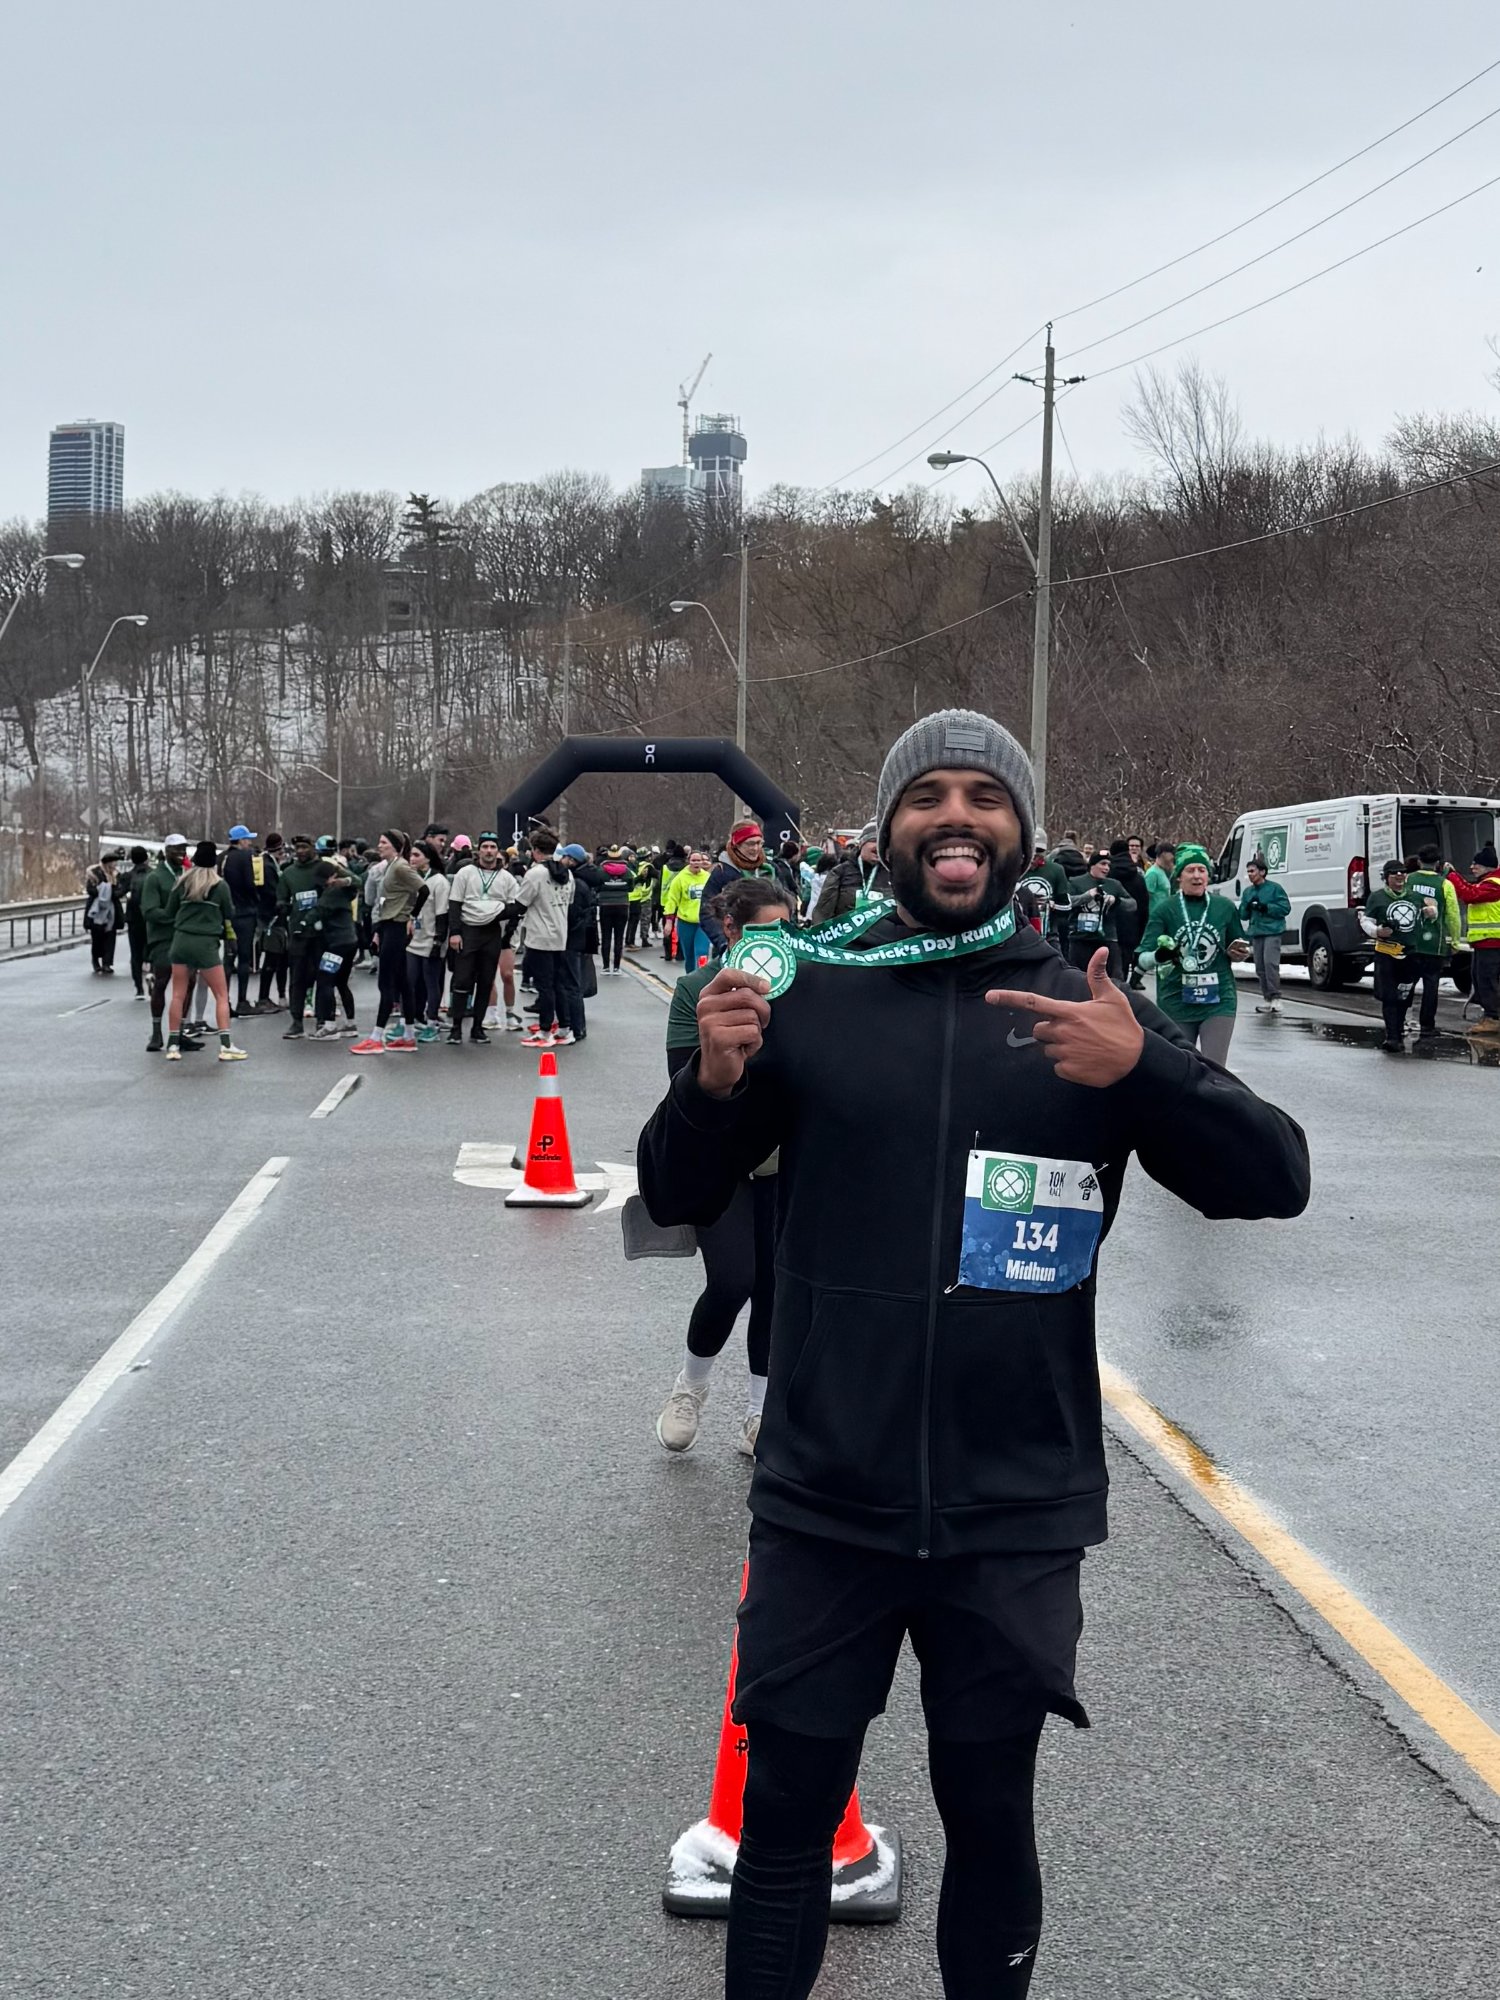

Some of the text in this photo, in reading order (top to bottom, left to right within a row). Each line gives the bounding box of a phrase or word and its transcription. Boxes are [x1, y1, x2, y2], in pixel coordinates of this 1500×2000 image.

[851, 905, 882, 927] Day
[843, 944, 921, 962] Patrick's
[922, 935, 957, 952] Day
[961, 924, 994, 944] Run
[994, 910, 1013, 933] 10K
[1049, 1171, 1066, 1188] 10K
[1012, 1219, 1060, 1253] 134
[1005, 1259, 1056, 1282] Midhun
